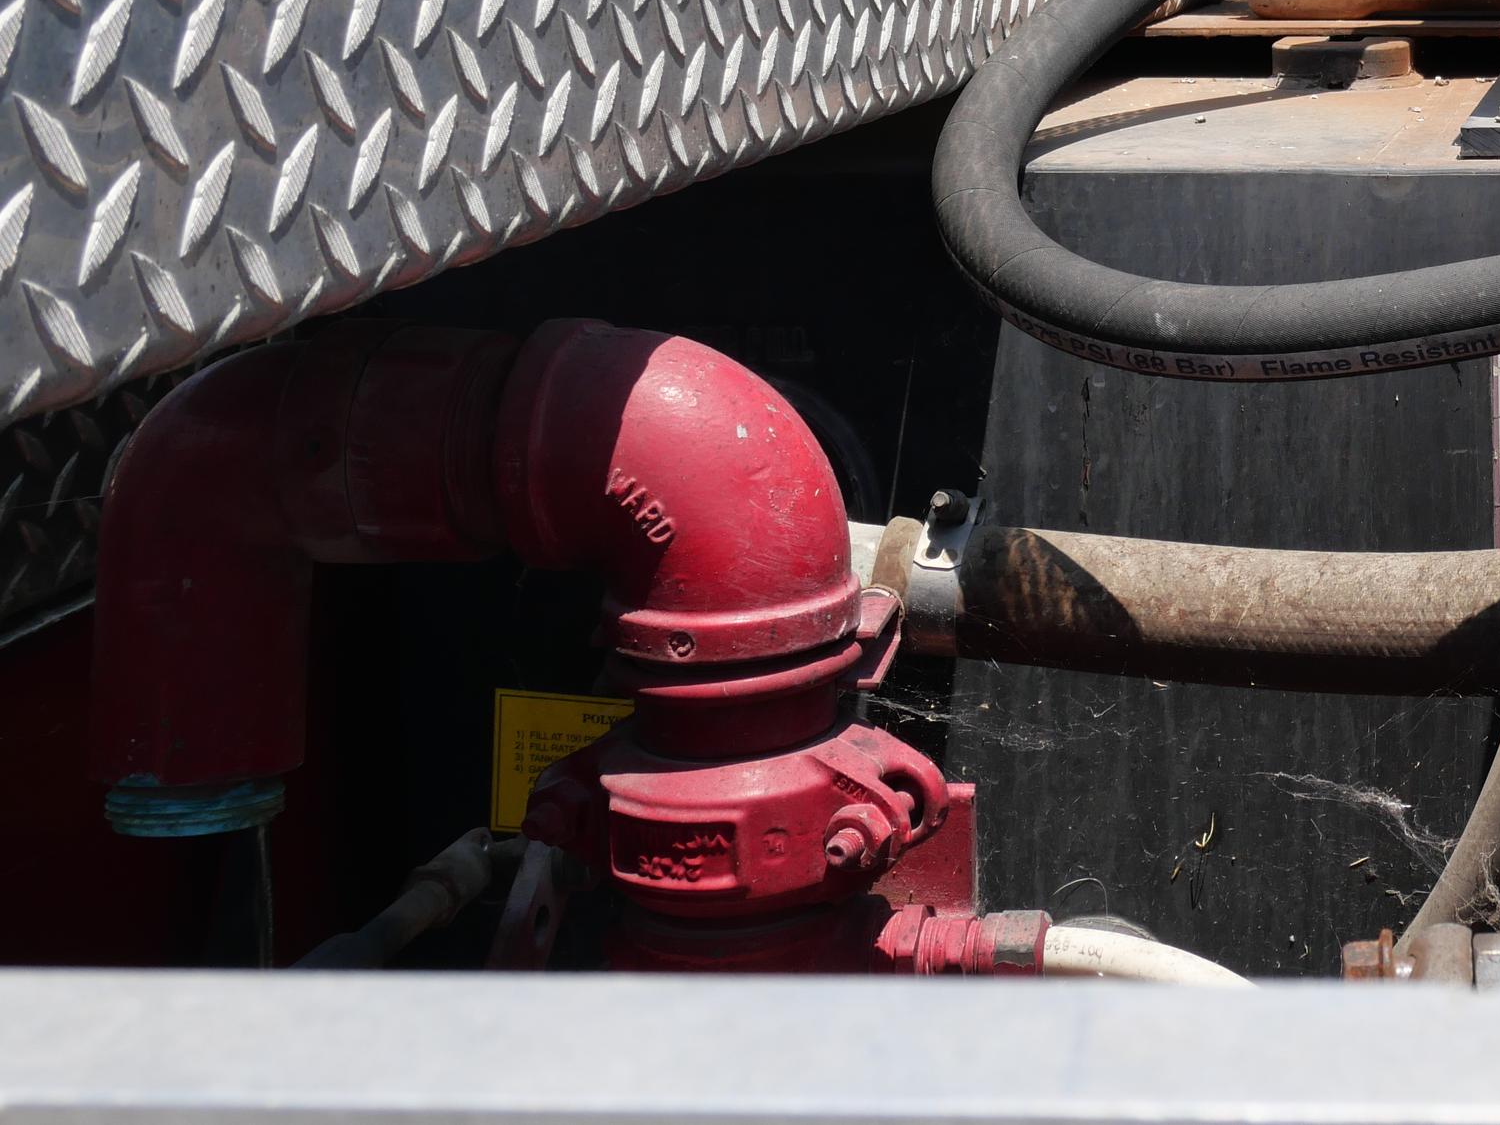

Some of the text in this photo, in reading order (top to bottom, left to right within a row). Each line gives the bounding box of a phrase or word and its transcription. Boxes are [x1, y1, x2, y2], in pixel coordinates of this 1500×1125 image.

[1070, 336, 1114, 364] PSI
[1126, 351, 1167, 372] (88
[1175, 357, 1235, 377] Bar)
[1260, 359, 1352, 377] Flame
[1359, 333, 1500, 368] Resistant
